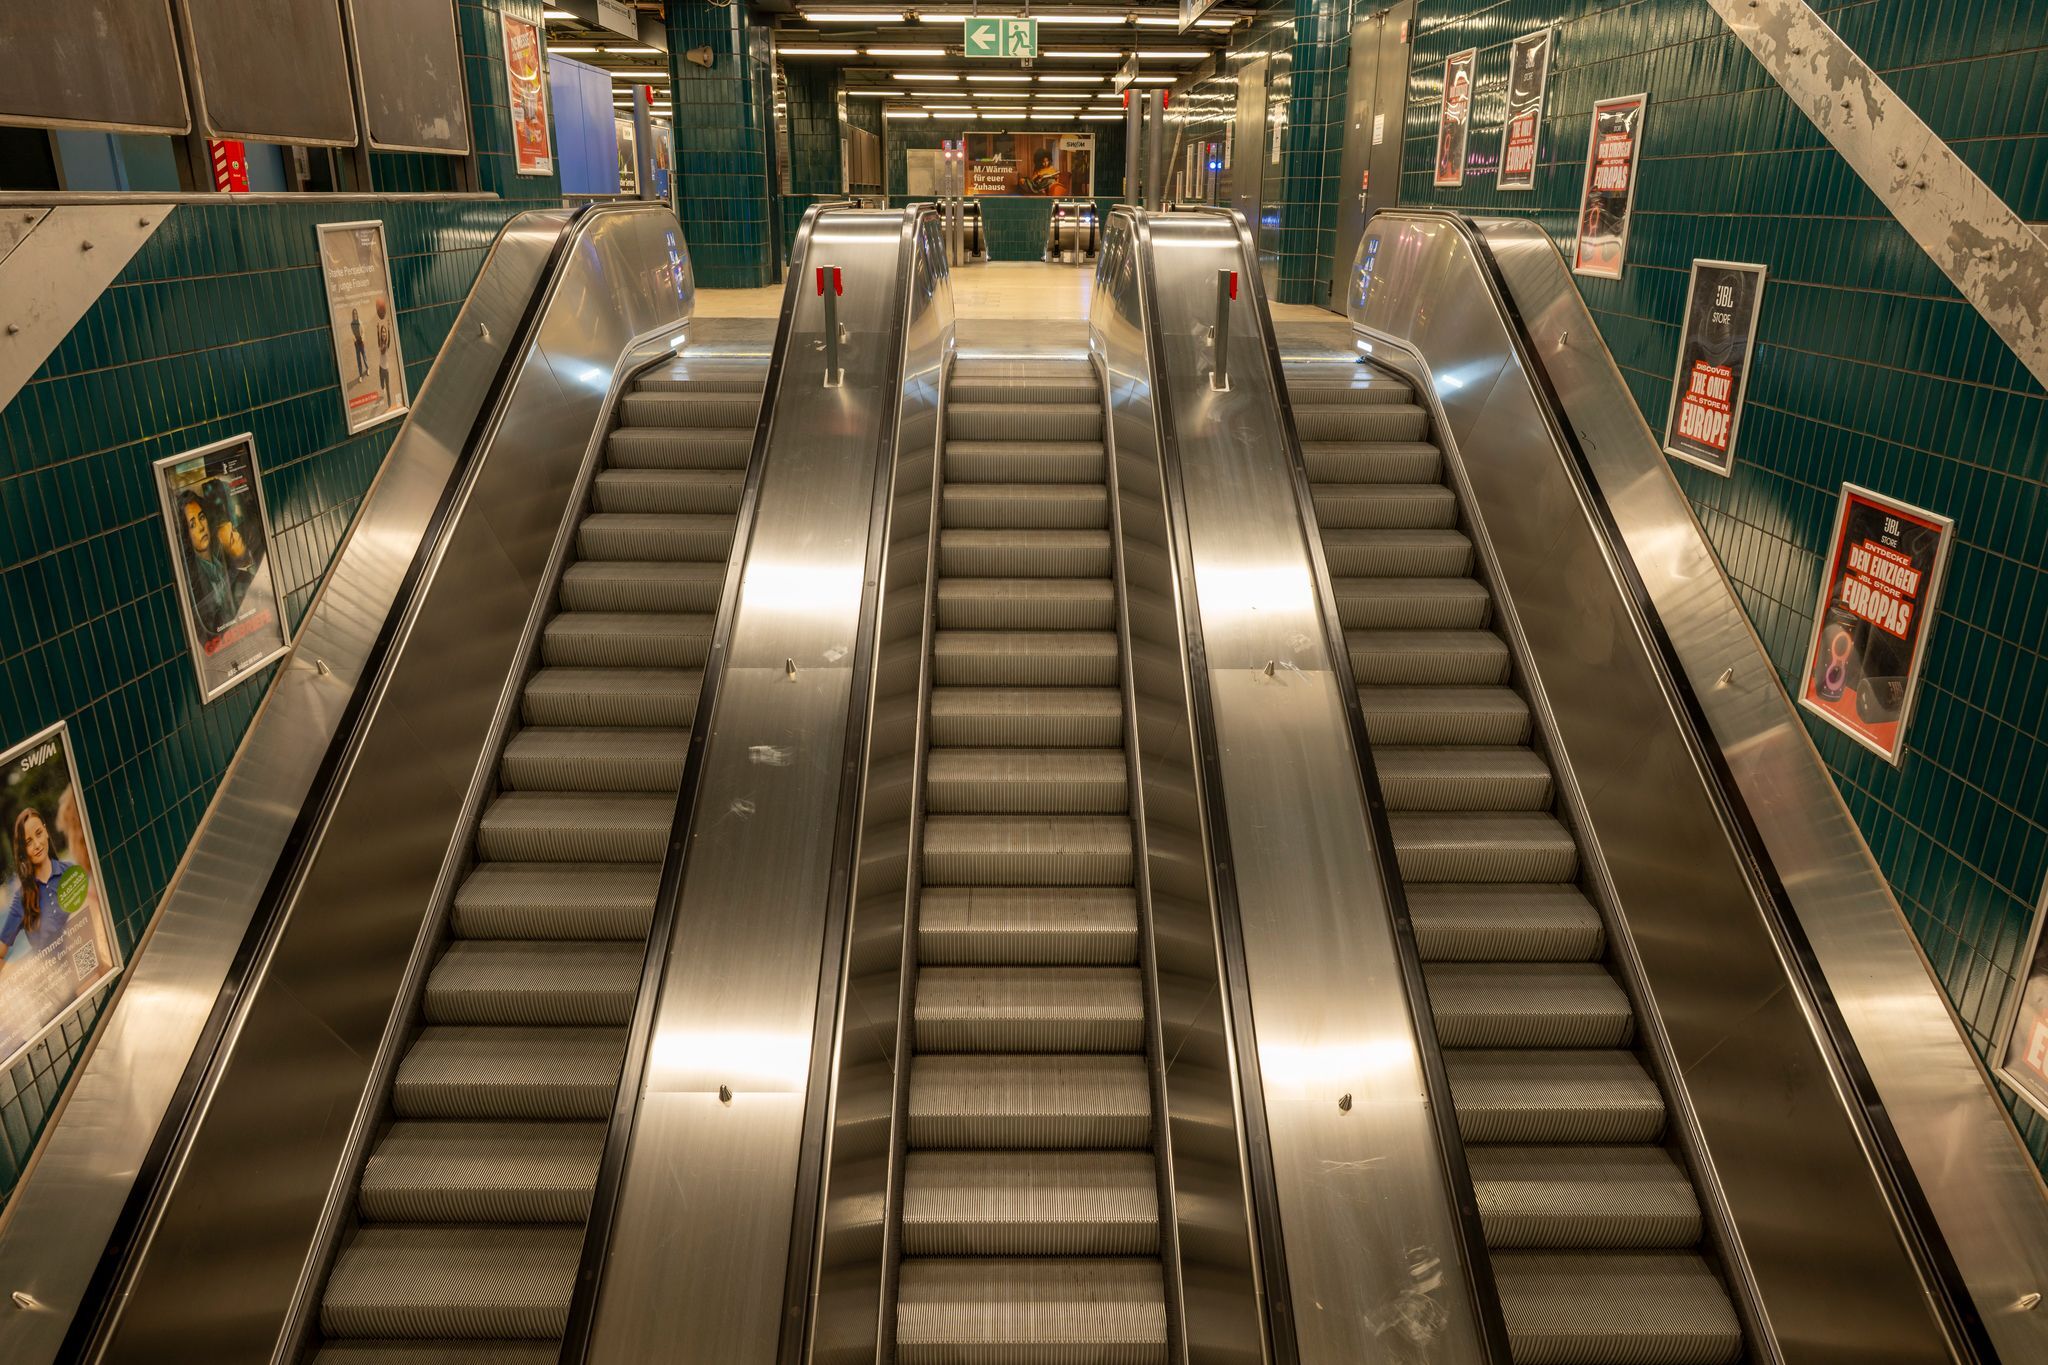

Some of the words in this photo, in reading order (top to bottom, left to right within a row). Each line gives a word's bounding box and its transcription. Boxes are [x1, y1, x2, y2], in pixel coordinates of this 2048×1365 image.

[1512, 121, 1521, 138] THE
[1521, 119, 1534, 137] ONLY
[1505, 144, 1534, 171] EUROPE
[1599, 142, 1609, 159] DEN
[1609, 141, 1632, 158] EINZIGEN
[973, 165, 1013, 173] M/Wärme
[973, 174, 986, 182] für
[1594, 165, 1628, 189] EUROPAS
[973, 183, 1006, 191] Zuhause
[1715, 285, 1734, 308] JBL
[1712, 311, 1731, 325] STORE
[1696, 363, 1730, 377] DISCOVER
[1691, 371, 1707, 395] THE
[1706, 375, 1730, 401] ONLY
[1686, 395, 1698, 403] JBL
[1699, 397, 1721, 409] STORE
[1721, 402, 1729, 411] IN
[1679, 401, 1731, 448] EUROPE
[1884, 516, 1900, 537] JBL
[1880, 535, 1898, 549] STORE
[1864, 542, 1909, 566] ENTDECKE
[1849, 546, 1871, 573] DEN
[1869, 555, 1919, 595] EINZIGEN
[1858, 574, 1872, 585] JBL
[1873, 581, 1902, 598] STORE
[1841, 576, 1910, 636] EUROPAS
